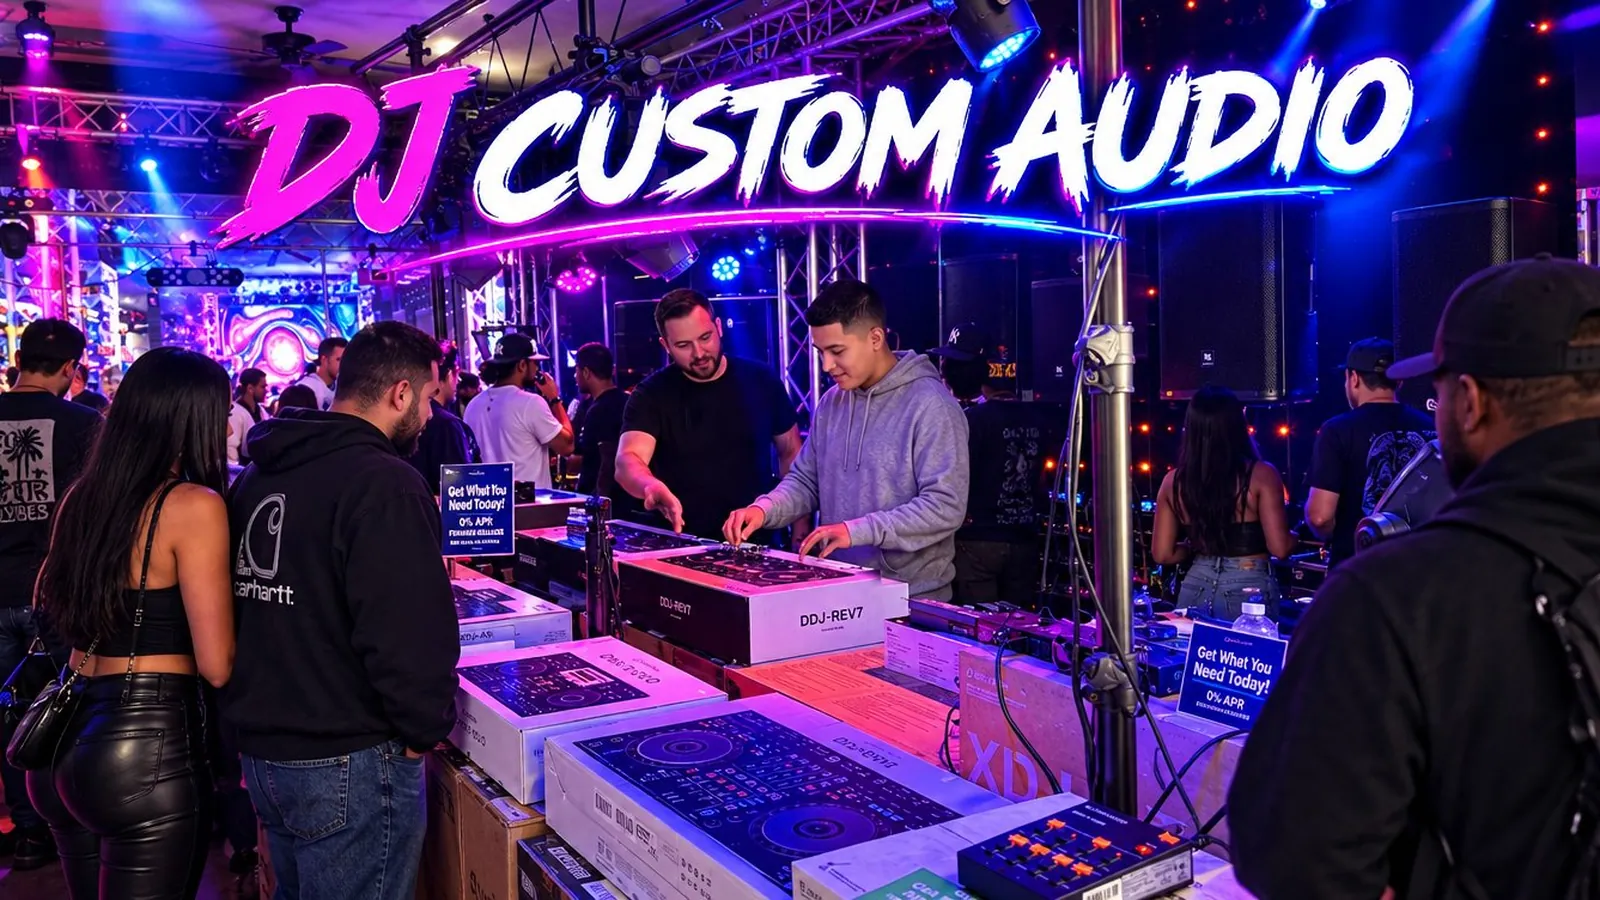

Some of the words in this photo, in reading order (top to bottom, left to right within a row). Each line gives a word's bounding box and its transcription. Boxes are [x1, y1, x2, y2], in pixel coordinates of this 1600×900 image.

[213, 65, 481, 248] DJ
[473, 72, 973, 226] CUSTOM
[987, 55, 1413, 214] AUDIO
[448, 485, 465, 498] Get
[491, 483, 507, 496] You
[448, 499, 473, 511] Need
[800, 606, 864, 627] DDJ-REV7
[1197, 645, 1217, 662] Get
[1220, 648, 1248, 670] What
[1251, 657, 1272, 675] You
[1193, 661, 1226, 682] Need
[1228, 669, 1270, 696] Today!
[1206, 690, 1222, 703] 0%
[1223, 695, 1245, 710] APR
